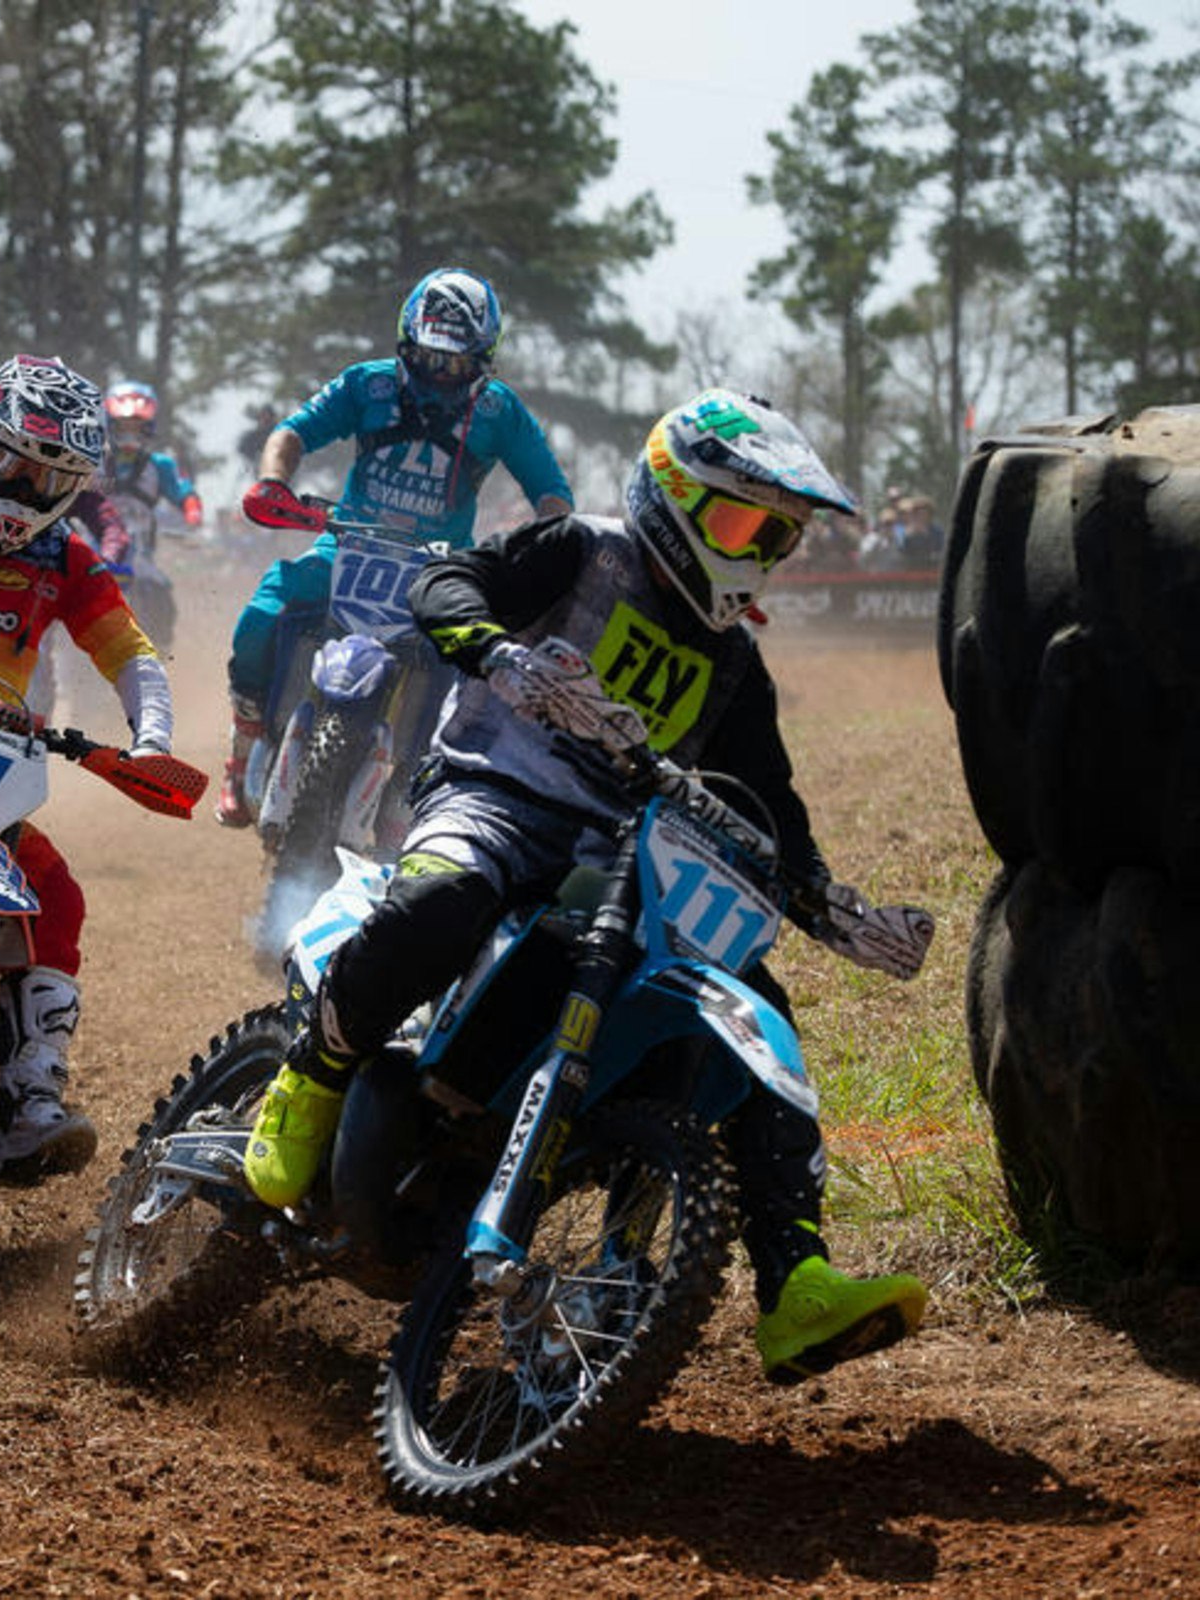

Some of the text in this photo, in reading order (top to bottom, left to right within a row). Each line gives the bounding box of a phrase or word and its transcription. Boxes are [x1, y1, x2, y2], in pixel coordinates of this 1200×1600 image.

[605, 624, 699, 719] FLY
[660, 857, 769, 972] 111
[493, 1081, 545, 1194] MAXXIS
